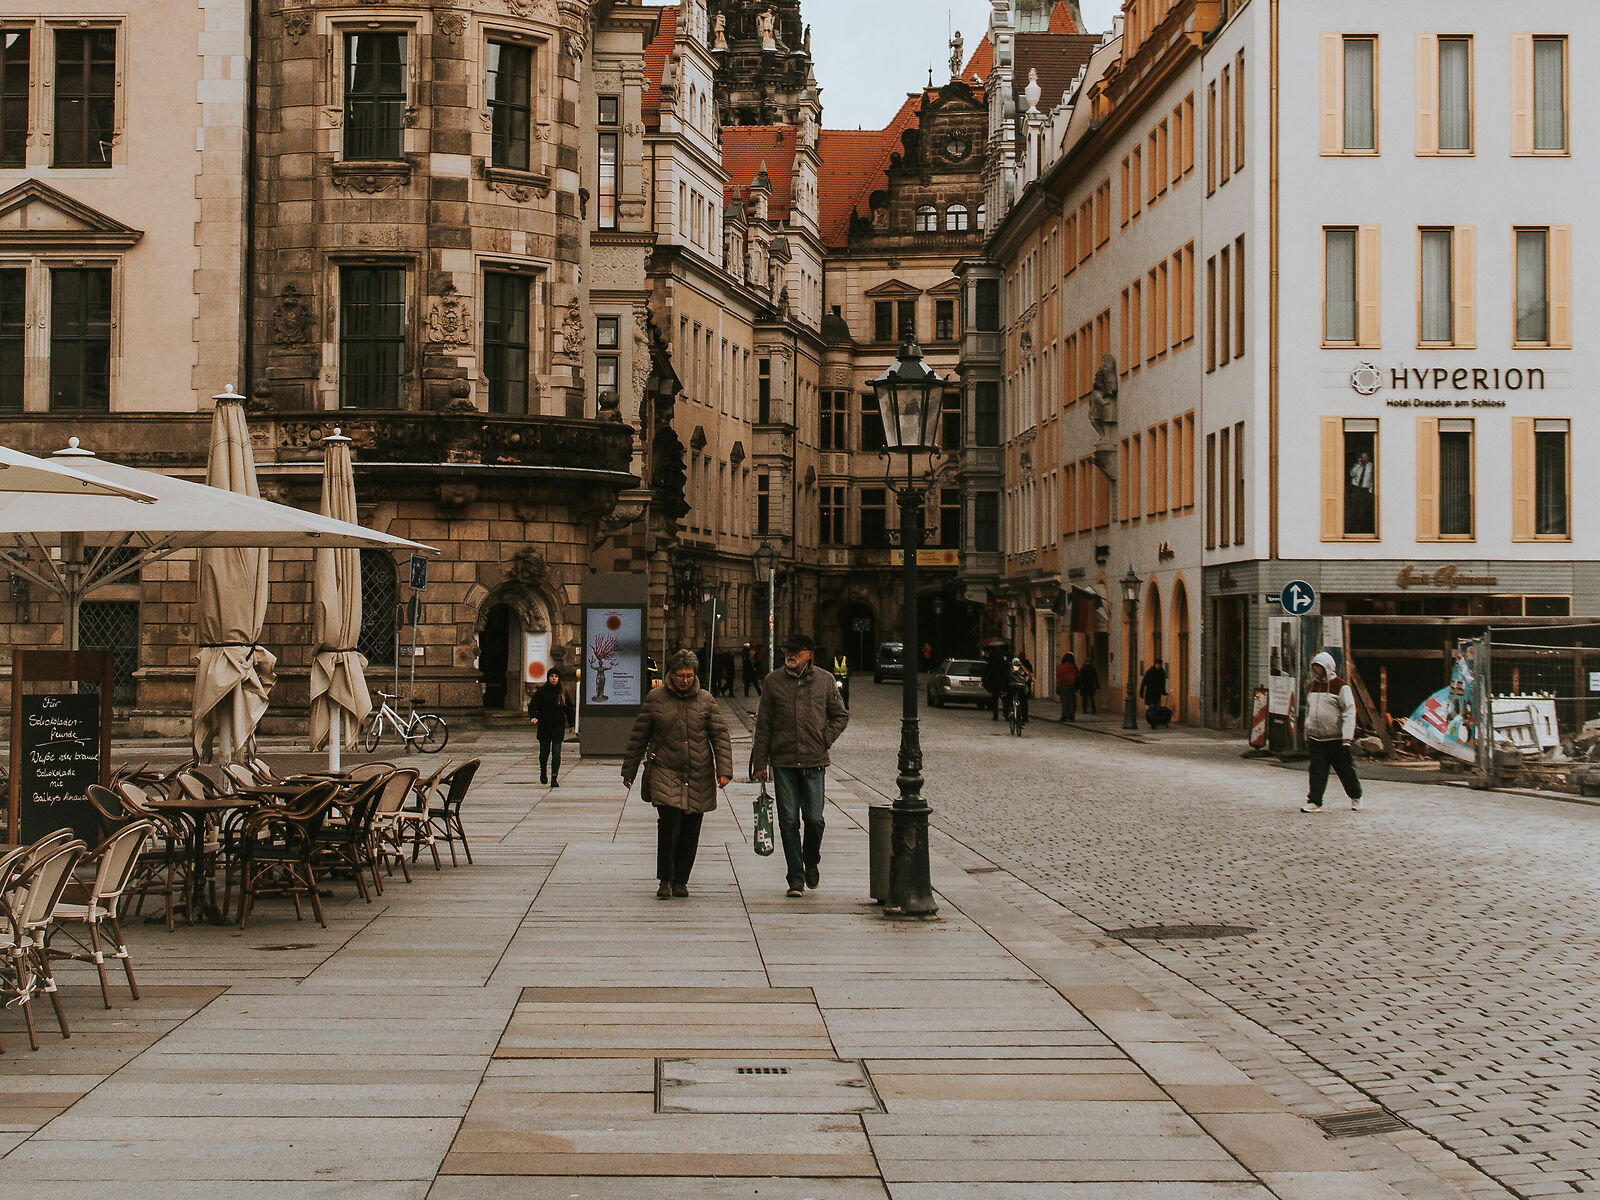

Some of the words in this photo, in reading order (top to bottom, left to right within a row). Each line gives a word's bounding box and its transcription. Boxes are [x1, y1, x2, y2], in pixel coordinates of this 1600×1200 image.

[1386, 398, 1411, 408] Hotel
[1413, 398, 1452, 408] Dresden
[1454, 400, 1470, 408] am
[1472, 398, 1506, 408] Schloss
[42, 695, 61, 708] Für
[49, 778, 64, 788] mit
